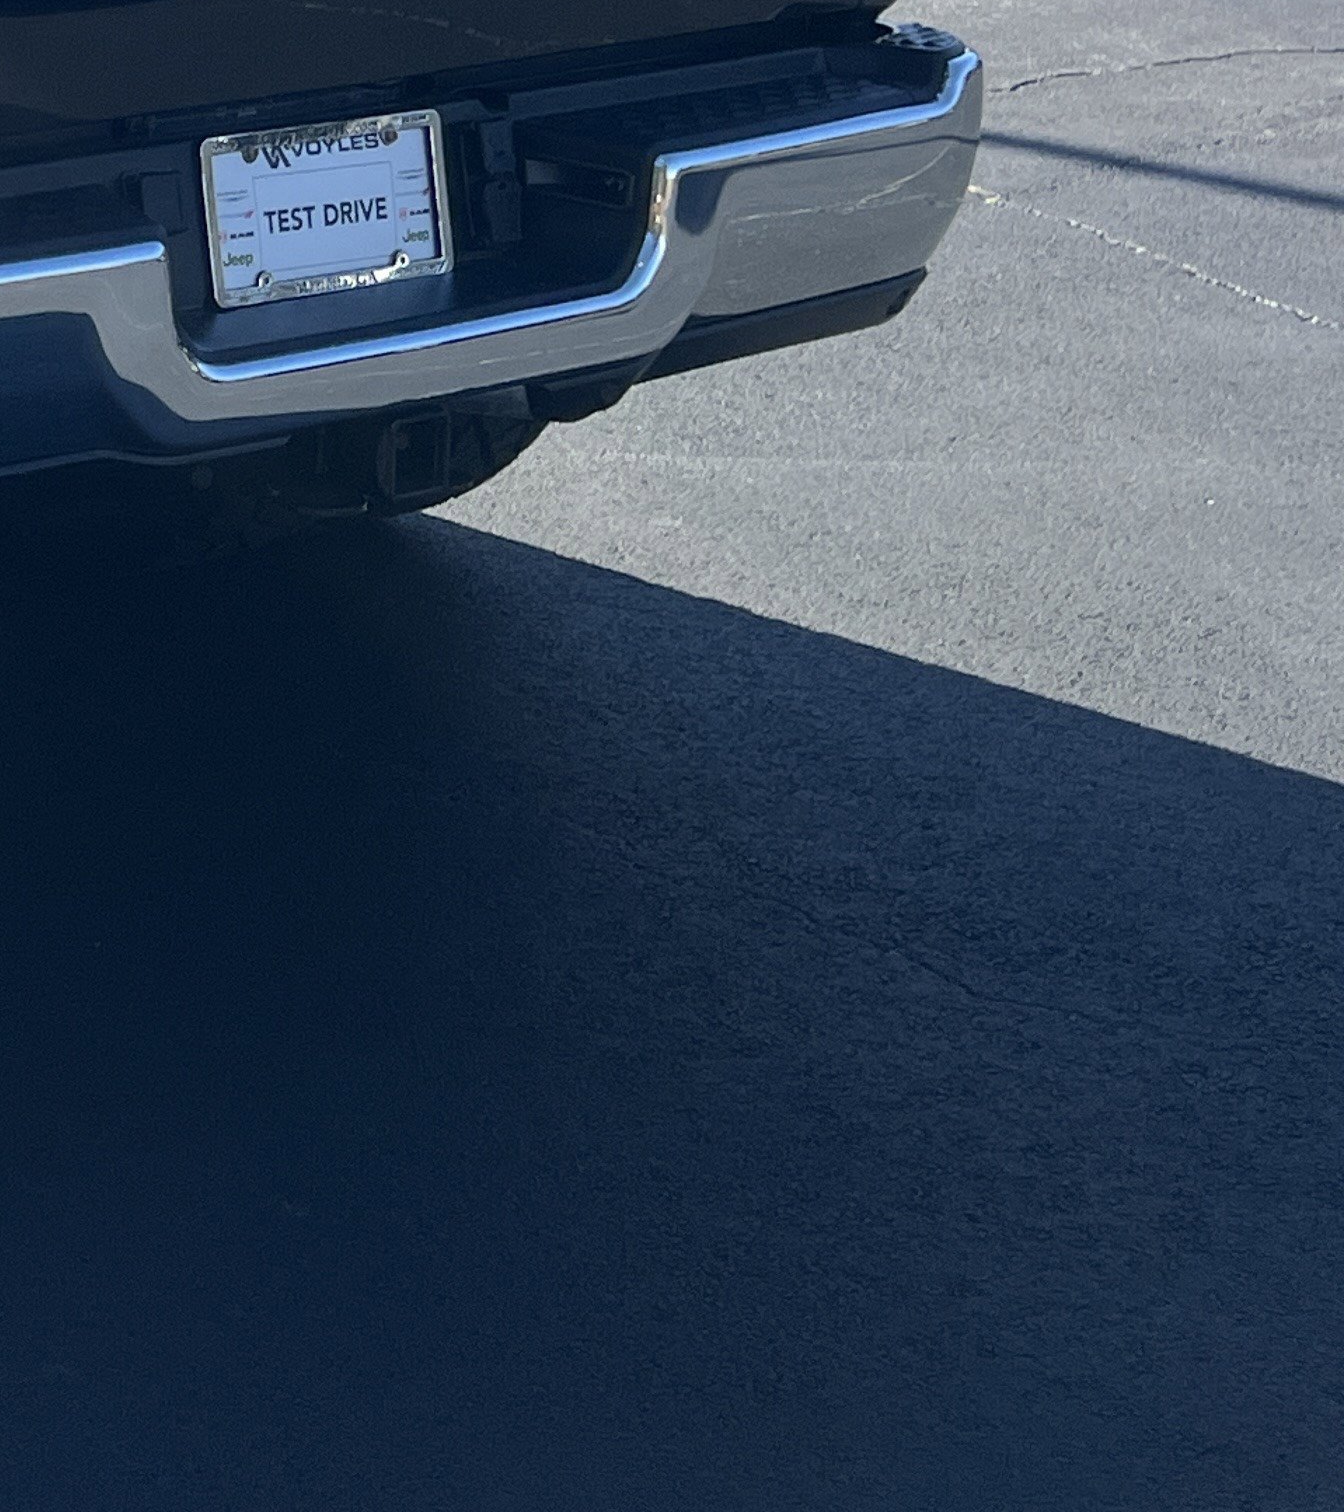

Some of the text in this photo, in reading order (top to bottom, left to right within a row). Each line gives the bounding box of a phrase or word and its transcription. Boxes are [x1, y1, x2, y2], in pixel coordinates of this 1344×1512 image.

[292, 132, 380, 158] VOYLES
[263, 196, 389, 235] TEST DRIVE
[402, 228, 430, 243] Jeep
[223, 252, 254, 267] Jeep
